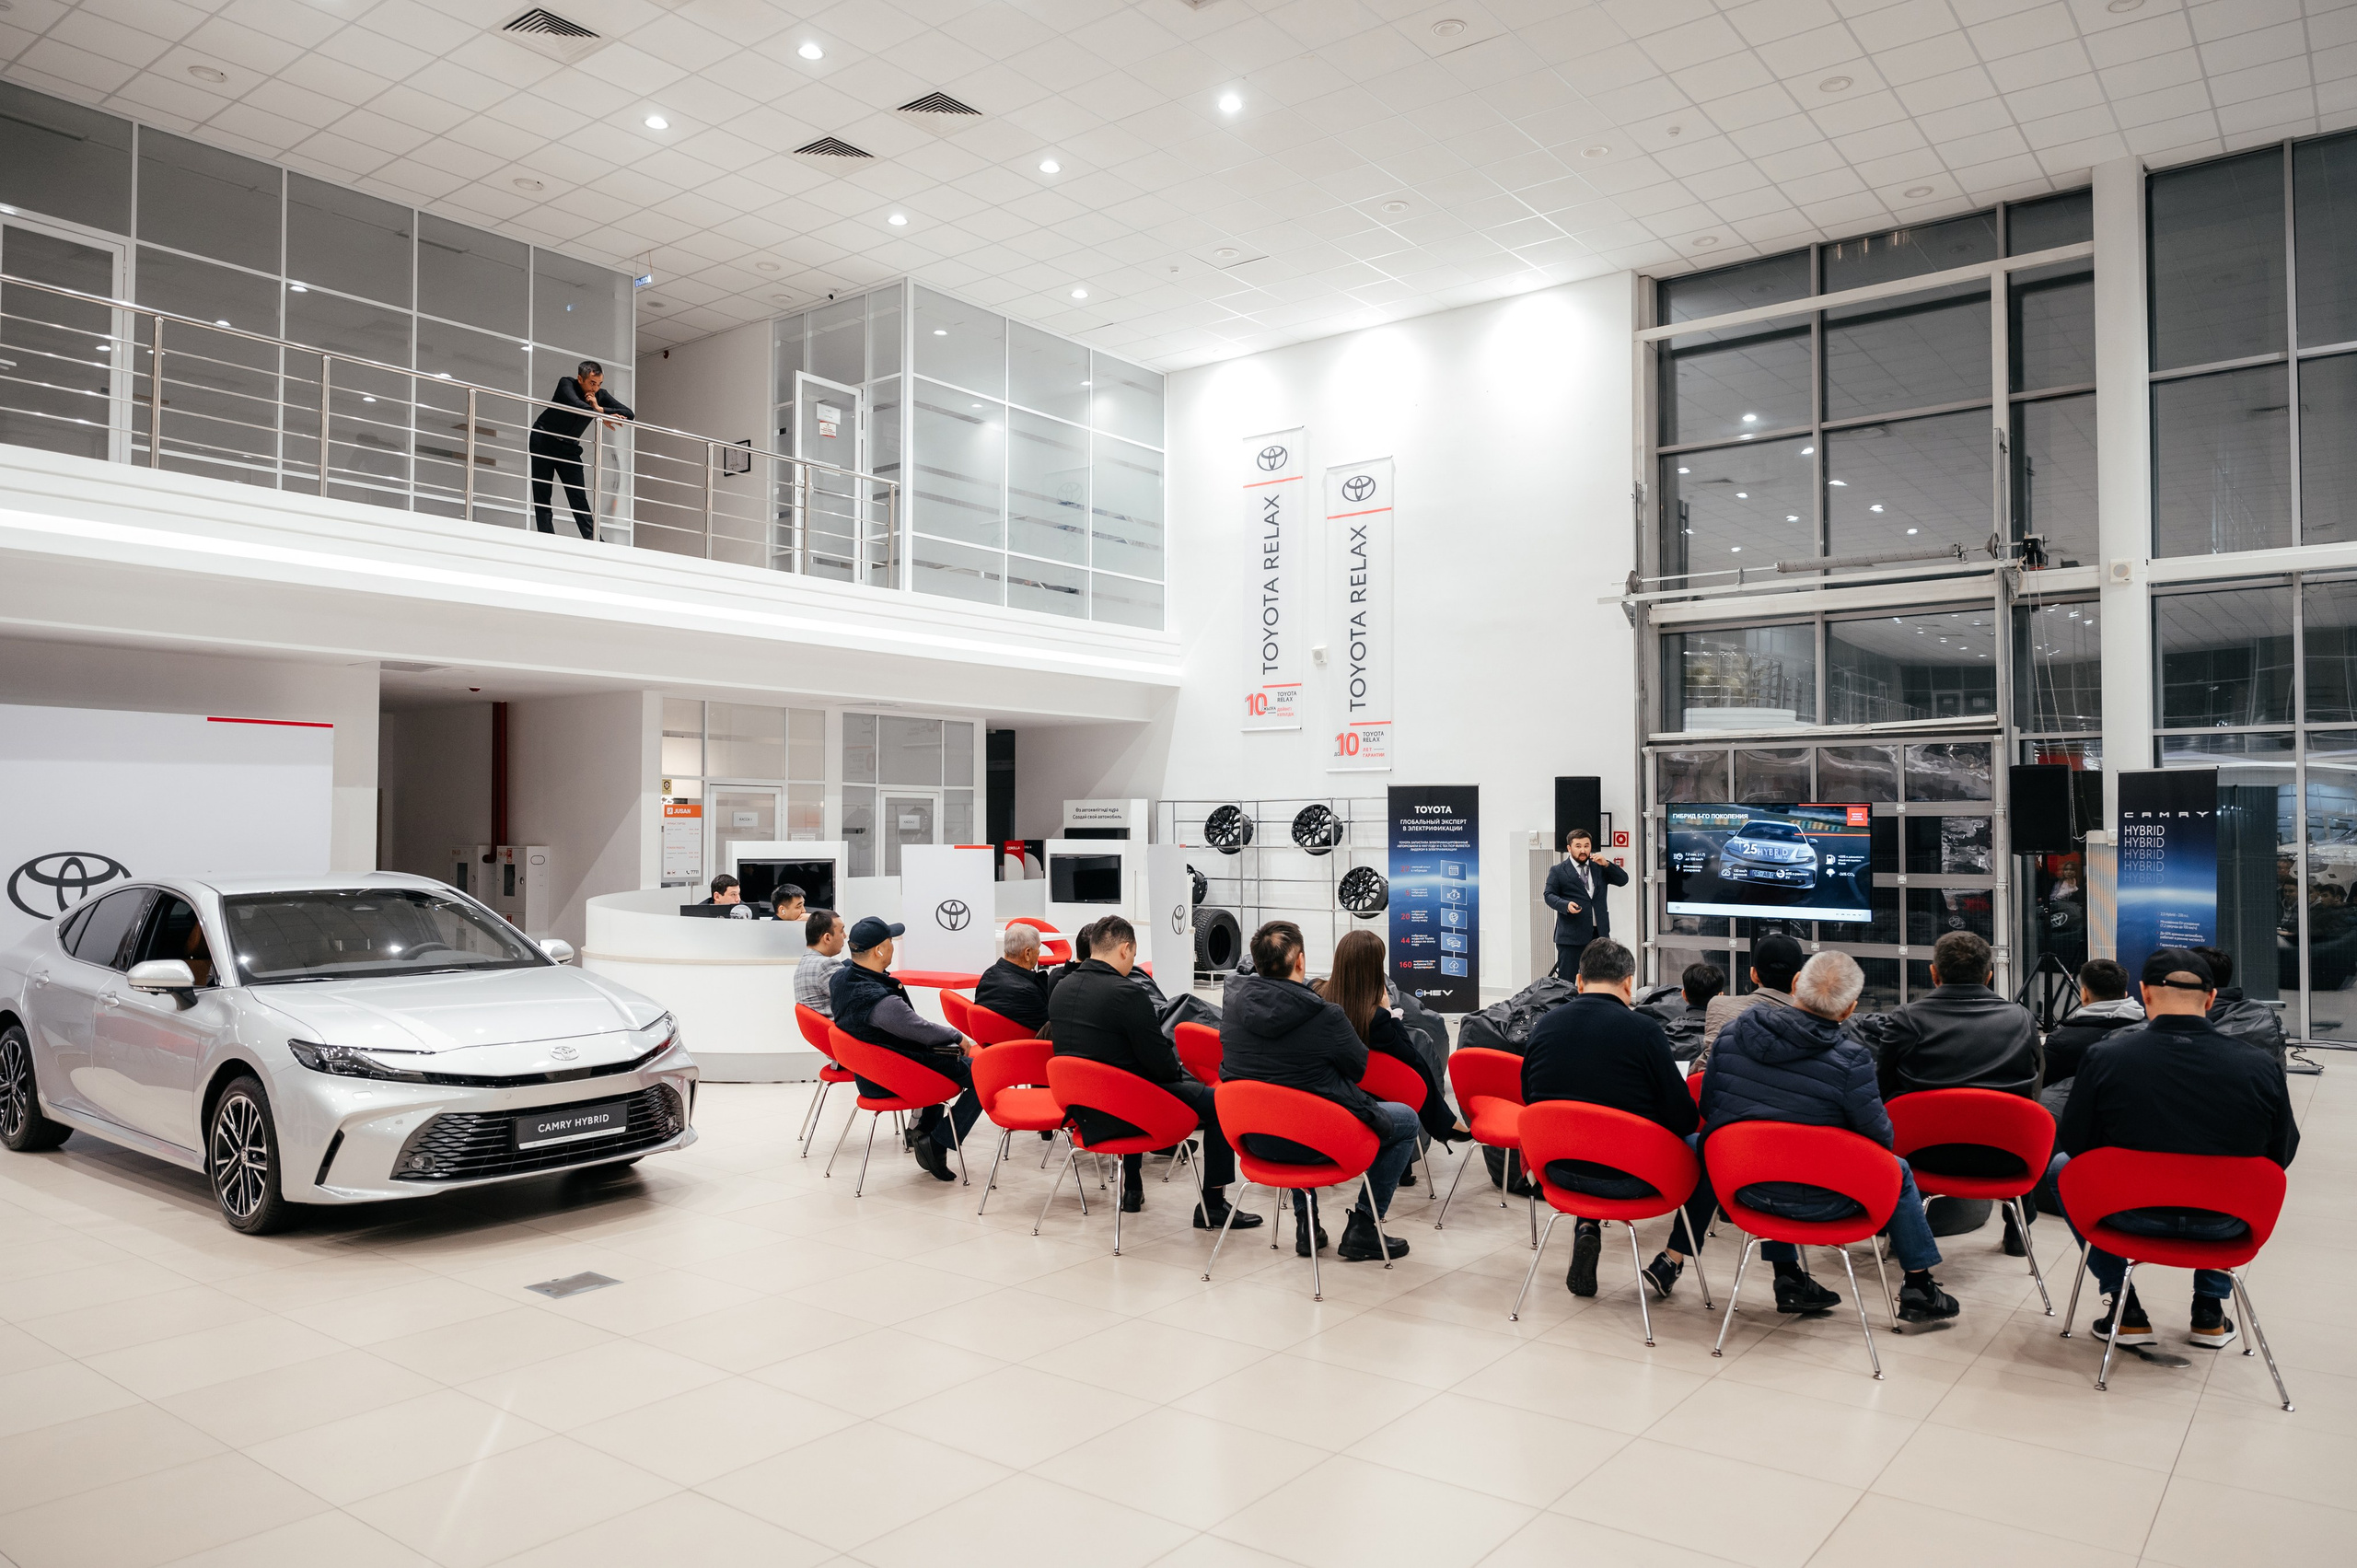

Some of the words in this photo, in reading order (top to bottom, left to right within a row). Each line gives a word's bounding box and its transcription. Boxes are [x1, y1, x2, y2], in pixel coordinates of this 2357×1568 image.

[1263, 494, 1280, 570] RELAX
[1351, 525, 1366, 603] RELAX
[1263, 576, 1279, 675] TOYOTA
[1350, 610, 1366, 712] TOYOTA
[1245, 692, 1267, 716] 10
[1335, 732, 1359, 756] 10
[2124, 825, 2165, 836] HYBRID
[2124, 837, 2165, 848] HYBRID
[1758, 848, 1788, 856] HYBRID
[2124, 849, 2165, 860] HYBRID
[2124, 861, 2164, 871] HYBRID
[2124, 872, 2164, 884] HYBRID
[538, 1120, 572, 1132] CAMRY
[575, 1114, 610, 1127] HYBRID
